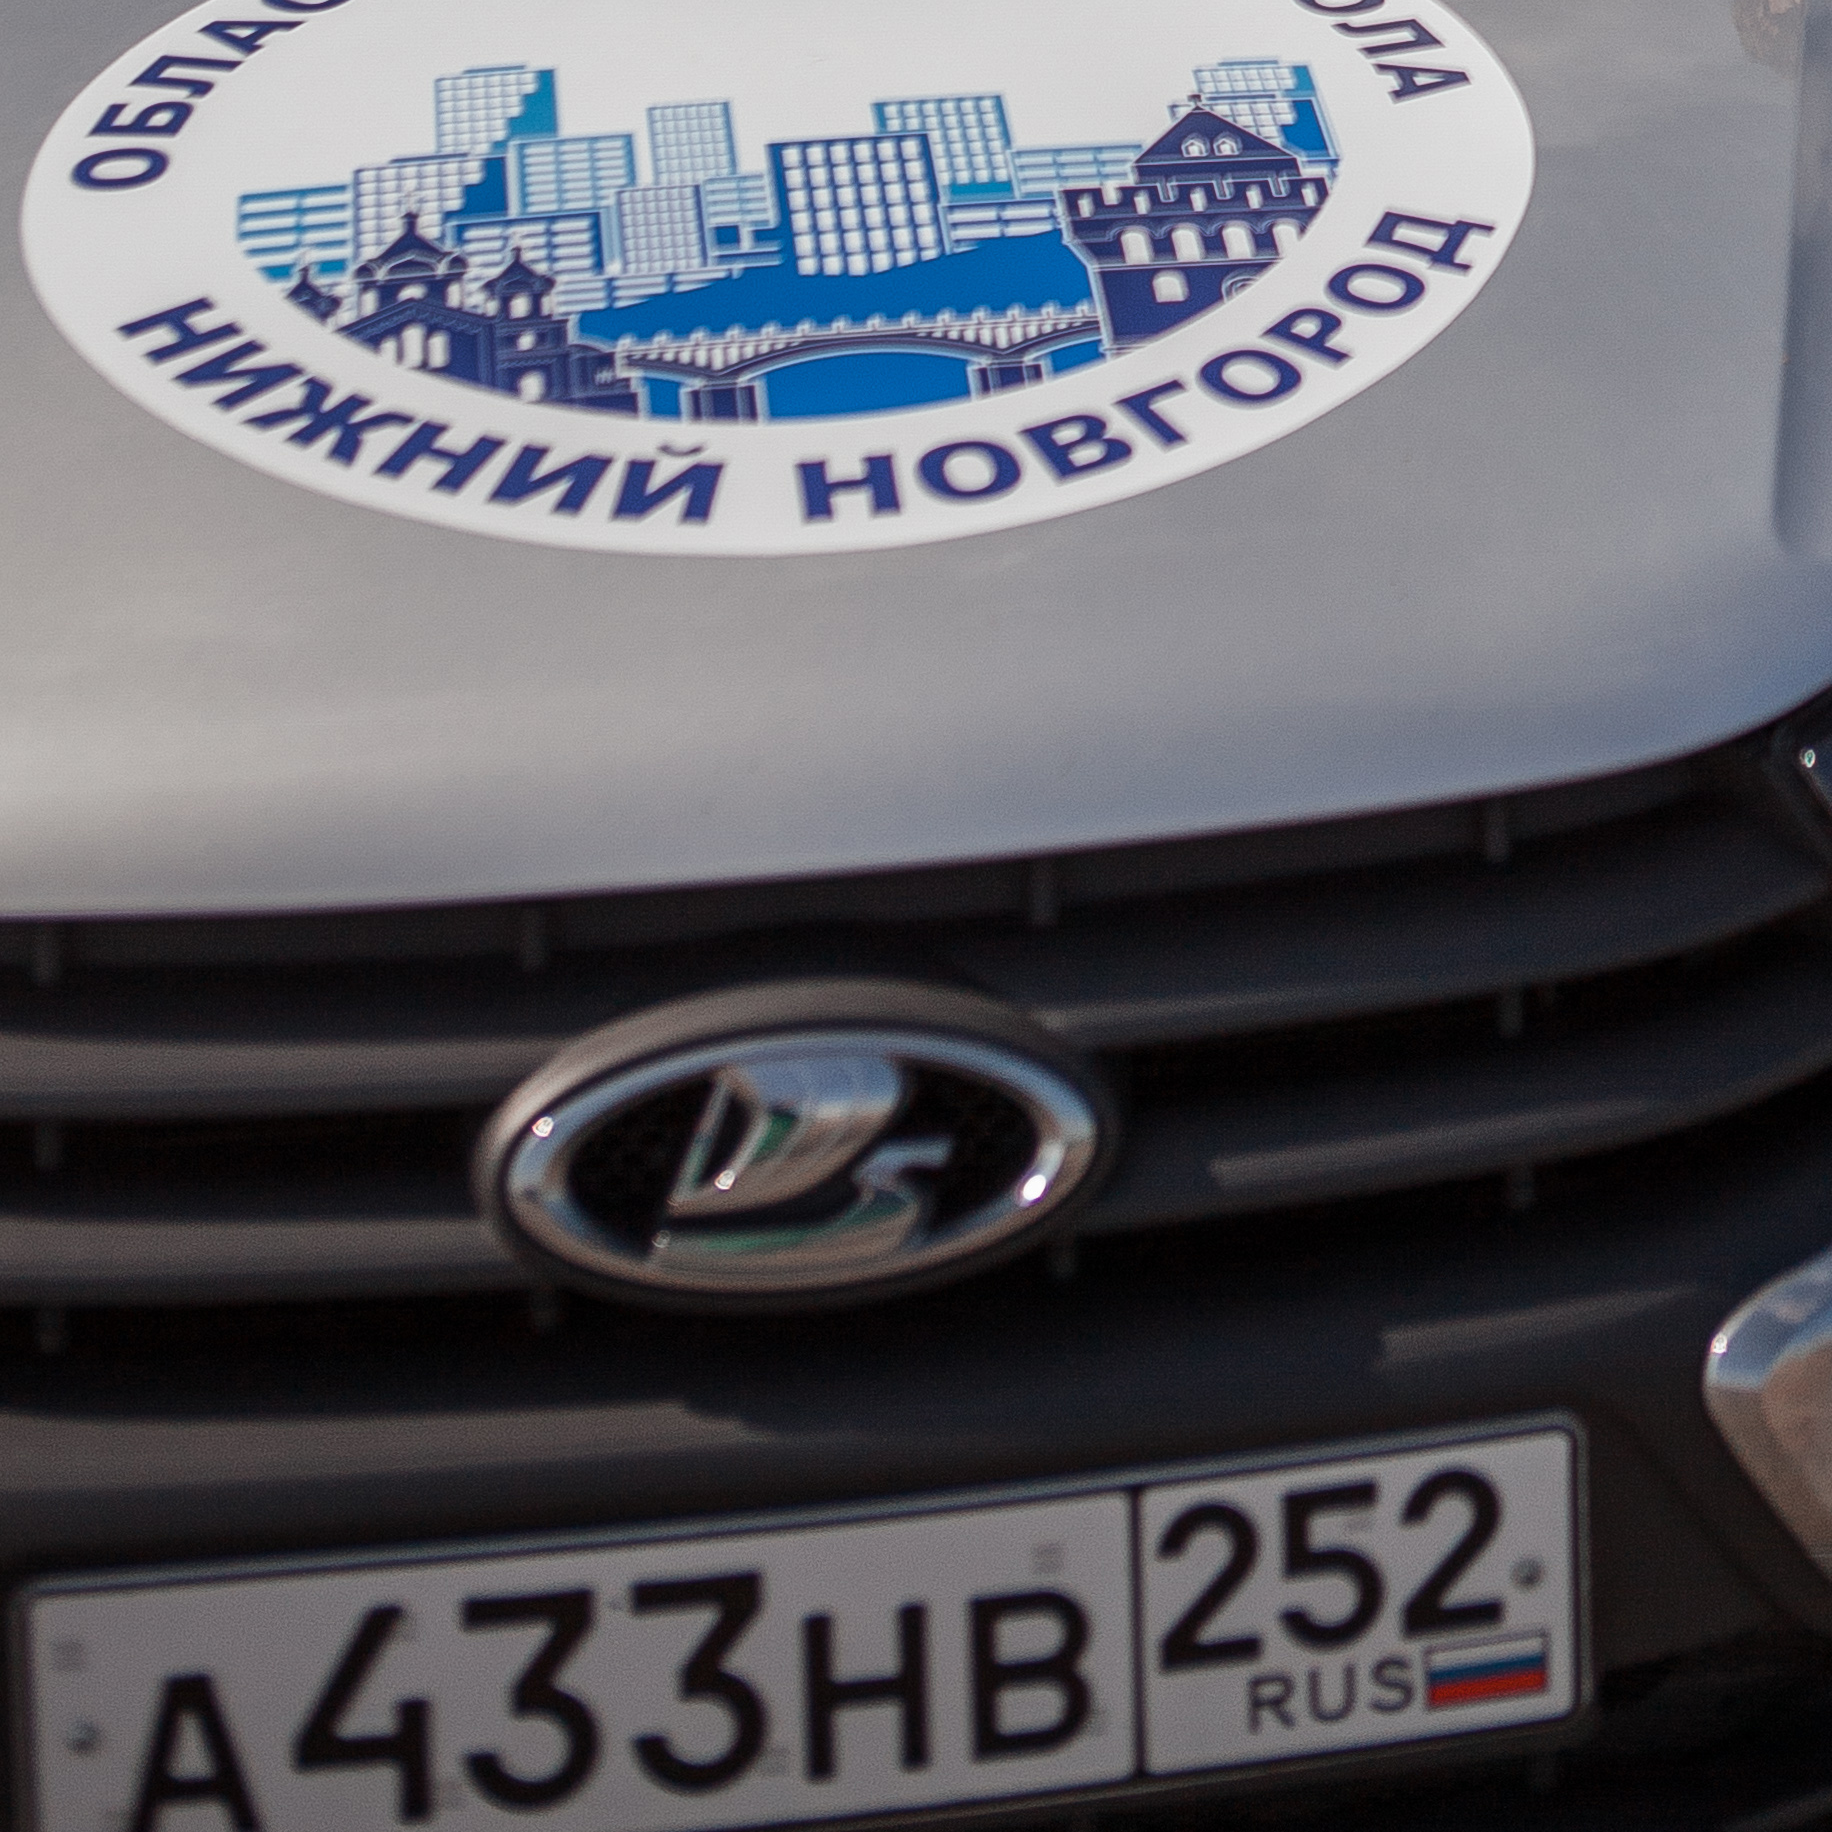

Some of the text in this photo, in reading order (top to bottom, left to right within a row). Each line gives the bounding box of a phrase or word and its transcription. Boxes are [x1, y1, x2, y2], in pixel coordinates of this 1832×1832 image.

[117, 210, 1496, 524] НИЖНИЙ НОВГОРОД
[1156, 1466, 1506, 1675] 252
[1246, 1656, 1415, 1731] RUS
